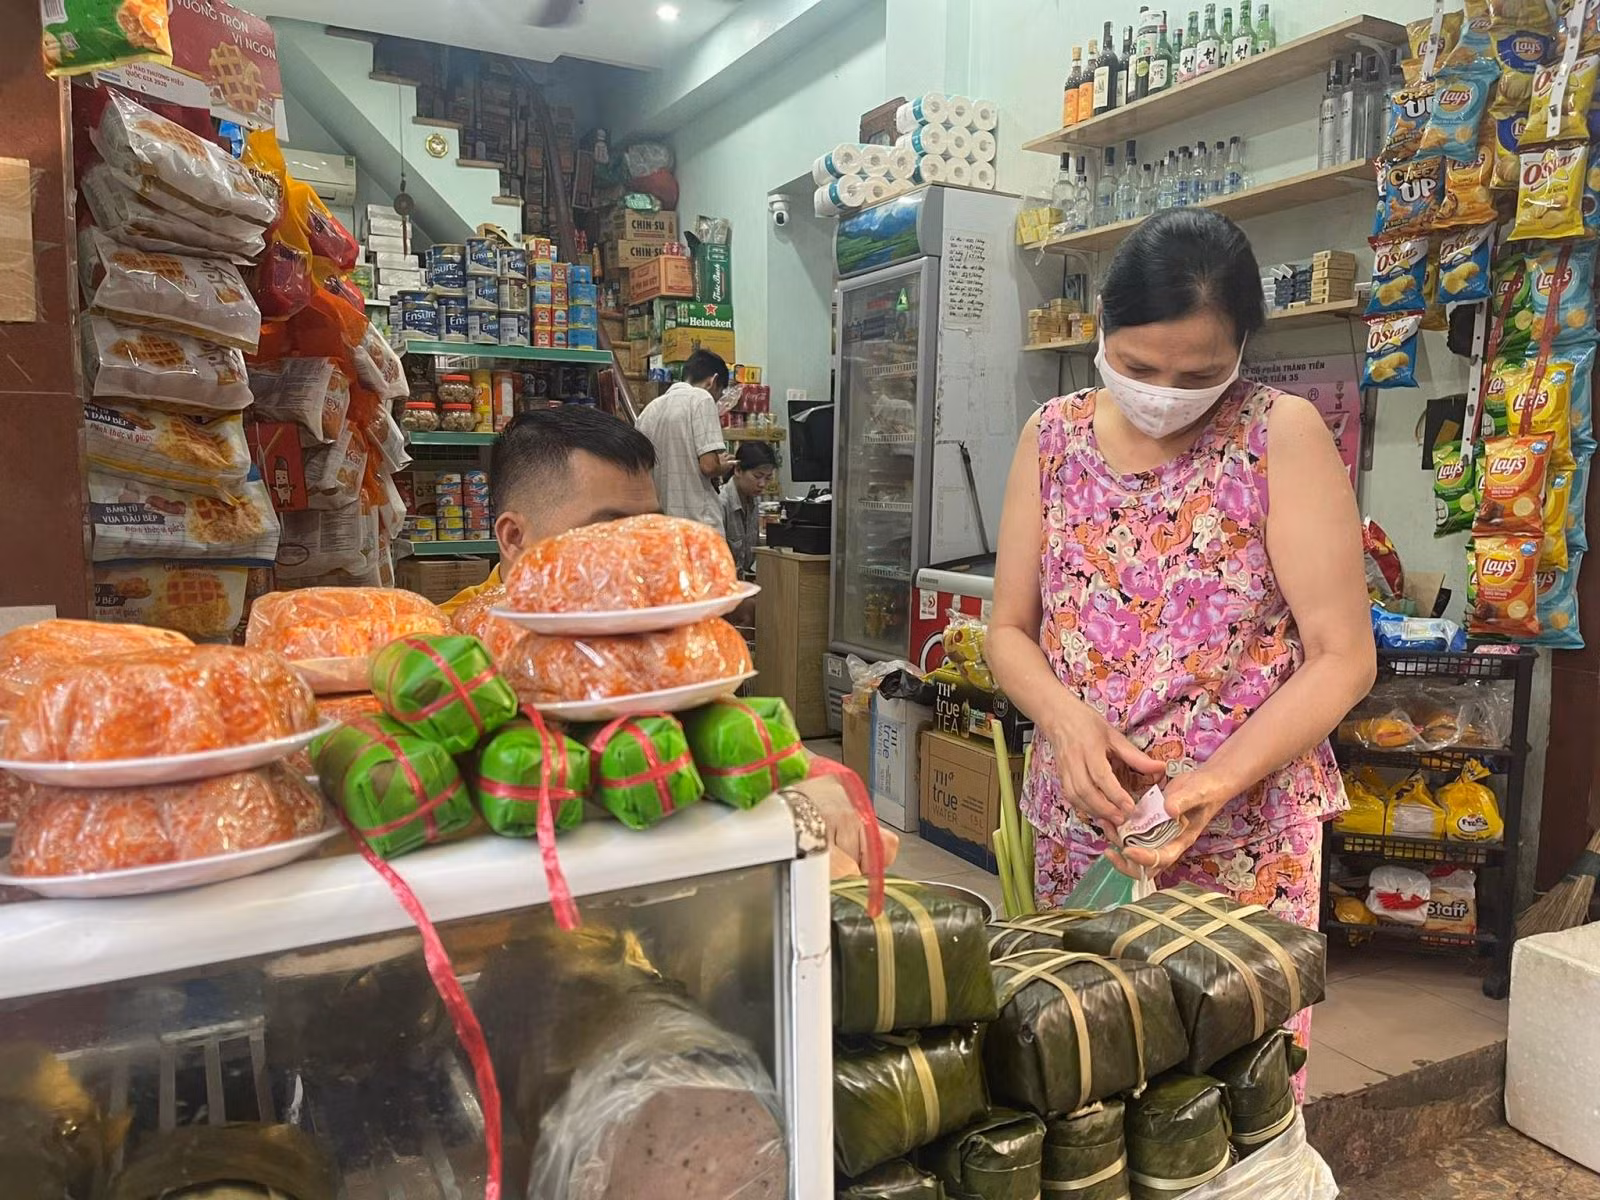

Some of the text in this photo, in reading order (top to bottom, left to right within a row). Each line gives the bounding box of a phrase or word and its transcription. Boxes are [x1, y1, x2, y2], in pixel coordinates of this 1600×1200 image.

[245, 37, 277, 60] NGON
[1398, 178, 1437, 203] UP
[405, 309, 436, 322] Ensure
[689, 316, 732, 329] Heineken
[1491, 456, 1525, 476] Lay's
[105, 505, 127, 514] BÁNH
[102, 515, 120, 524] VUA
[1482, 558, 1516, 577] Lay's
[936, 681, 951, 698] TH
[935, 695, 960, 718] true
[935, 711, 959, 736] TEA
[882, 724, 892, 759] true
[933, 768, 948, 787] TH
[932, 783, 958, 811] true
[932, 803, 958, 825] WATER
[1427, 900, 1467, 917] Staff
